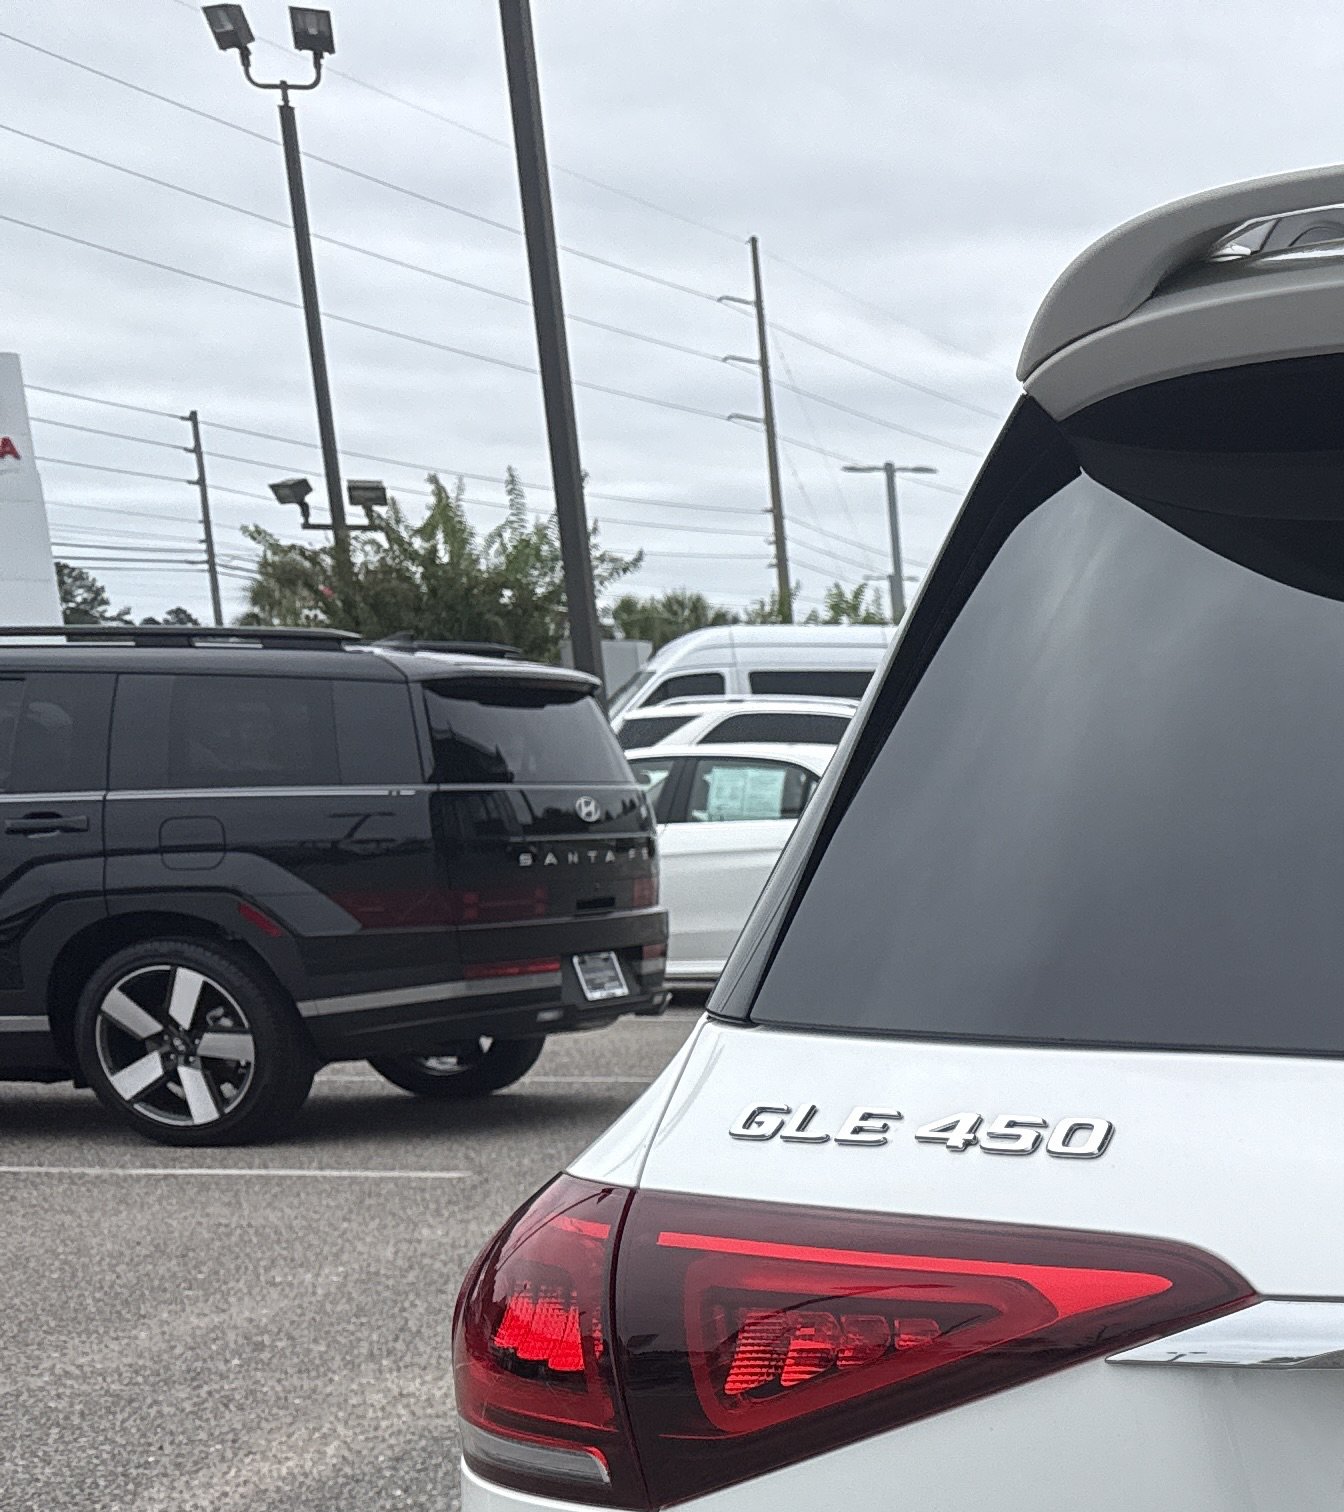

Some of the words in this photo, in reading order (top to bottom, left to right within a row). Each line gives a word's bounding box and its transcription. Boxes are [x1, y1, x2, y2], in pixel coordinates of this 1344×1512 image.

[519, 849, 616, 867] SANTA
[728, 1102, 904, 1146] GLE
[914, 1112, 1117, 1160] 450
